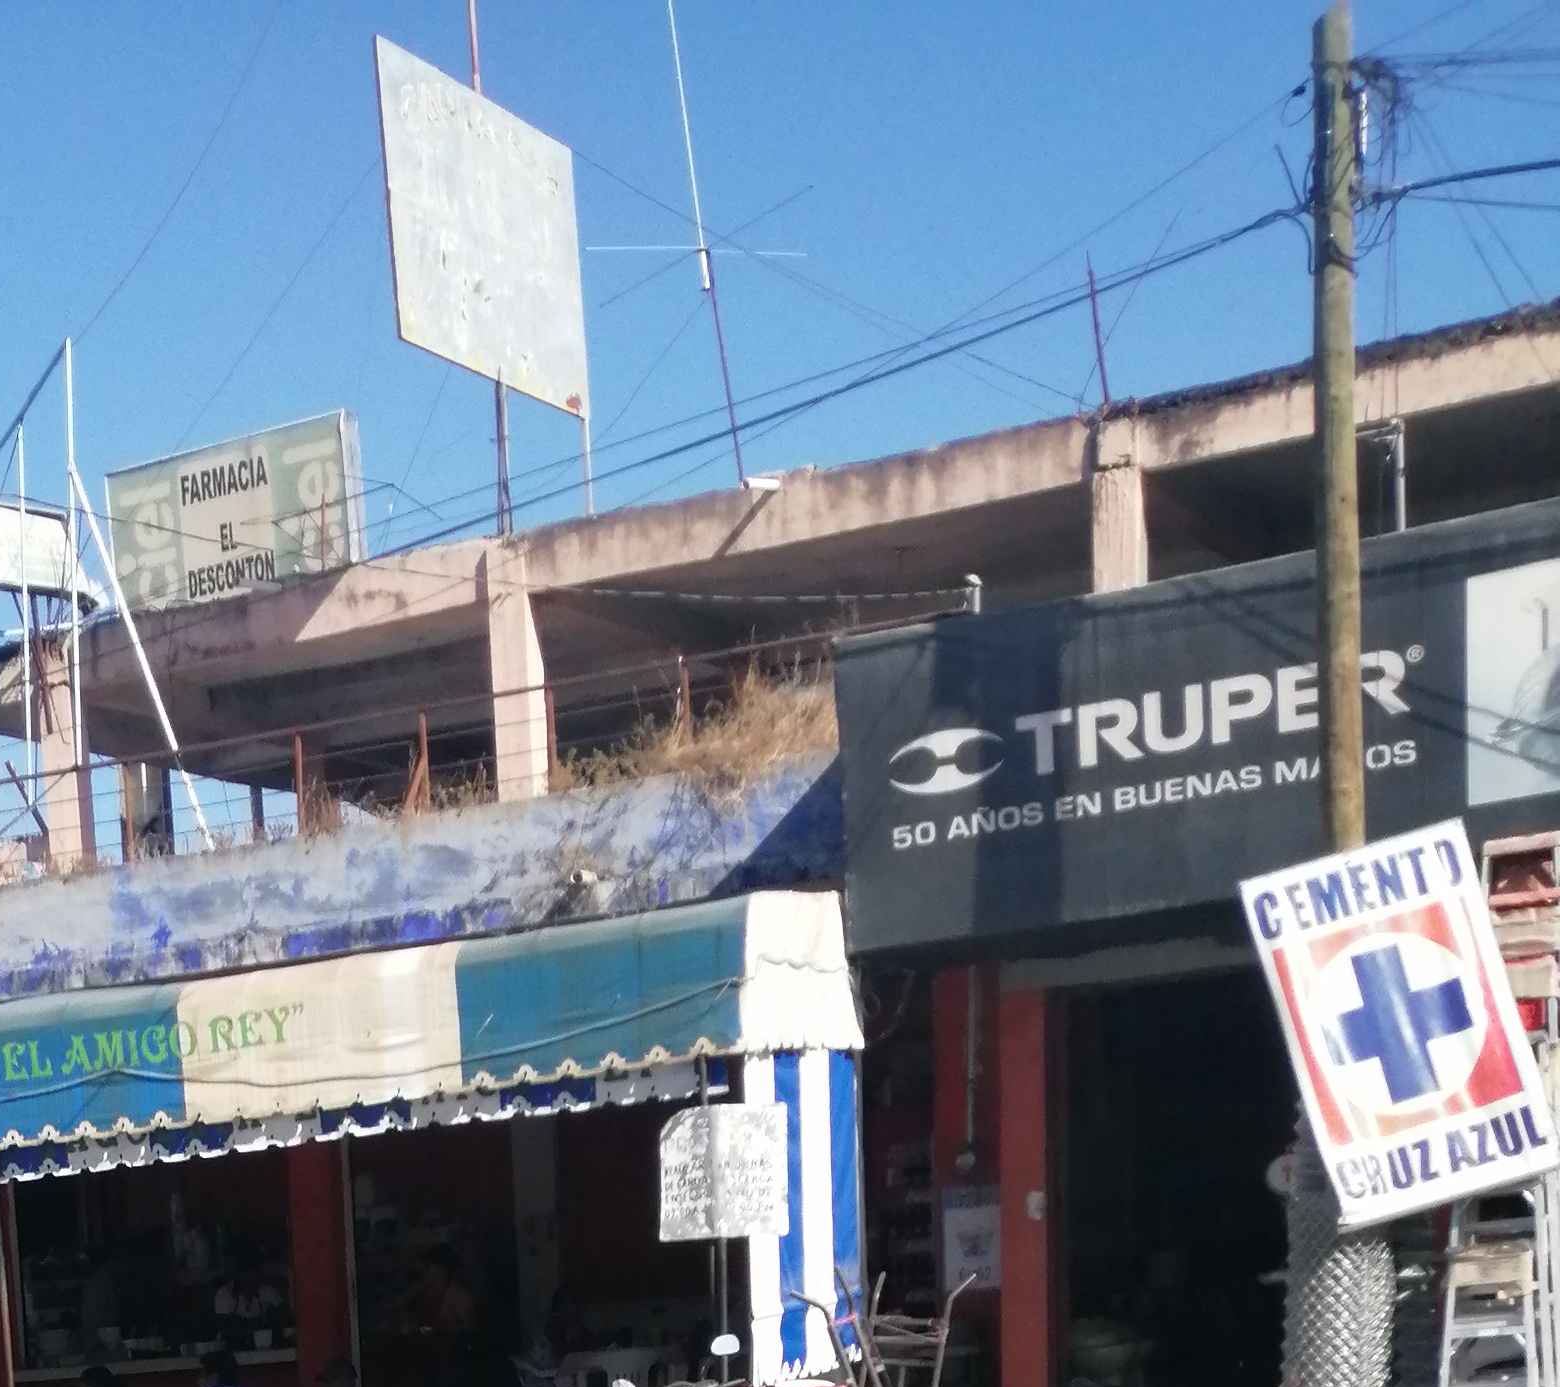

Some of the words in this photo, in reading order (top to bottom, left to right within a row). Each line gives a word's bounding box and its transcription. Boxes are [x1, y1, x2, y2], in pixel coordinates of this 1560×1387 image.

[180, 456, 268, 507] FARMACIA
[219, 521, 239, 552] EL
[188, 550, 276, 599] DESCONTON
[892, 822, 936, 850] 50
[947, 798, 1043, 842] AÑOS
[1055, 793, 1102, 821] EN
[1113, 765, 1262, 813] BUENAS
[61, 1018, 197, 1078] AMIGO
[1445, 1104, 1548, 1173] AZUL
